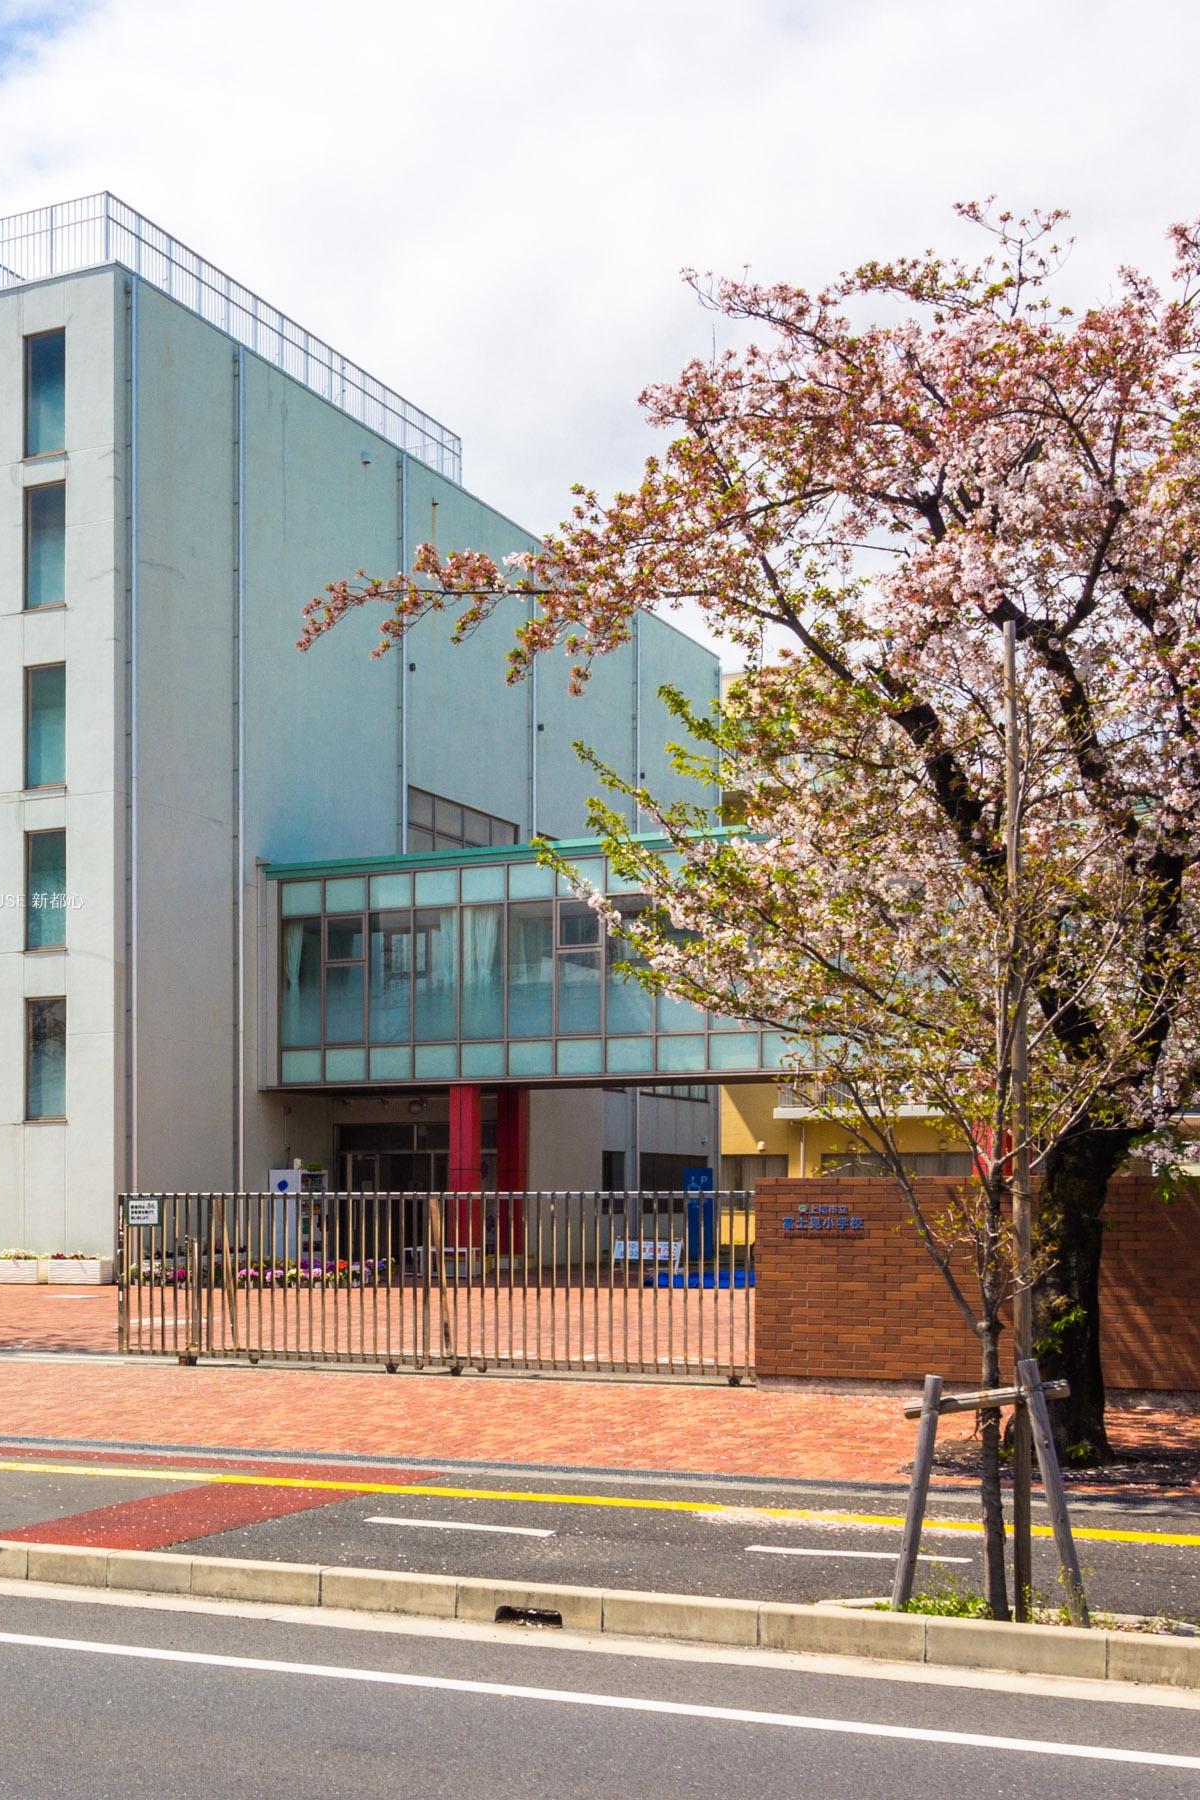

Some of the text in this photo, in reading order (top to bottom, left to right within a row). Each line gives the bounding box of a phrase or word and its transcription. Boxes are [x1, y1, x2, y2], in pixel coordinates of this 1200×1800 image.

[782, 1216, 864, 1230] 富士見小学校
